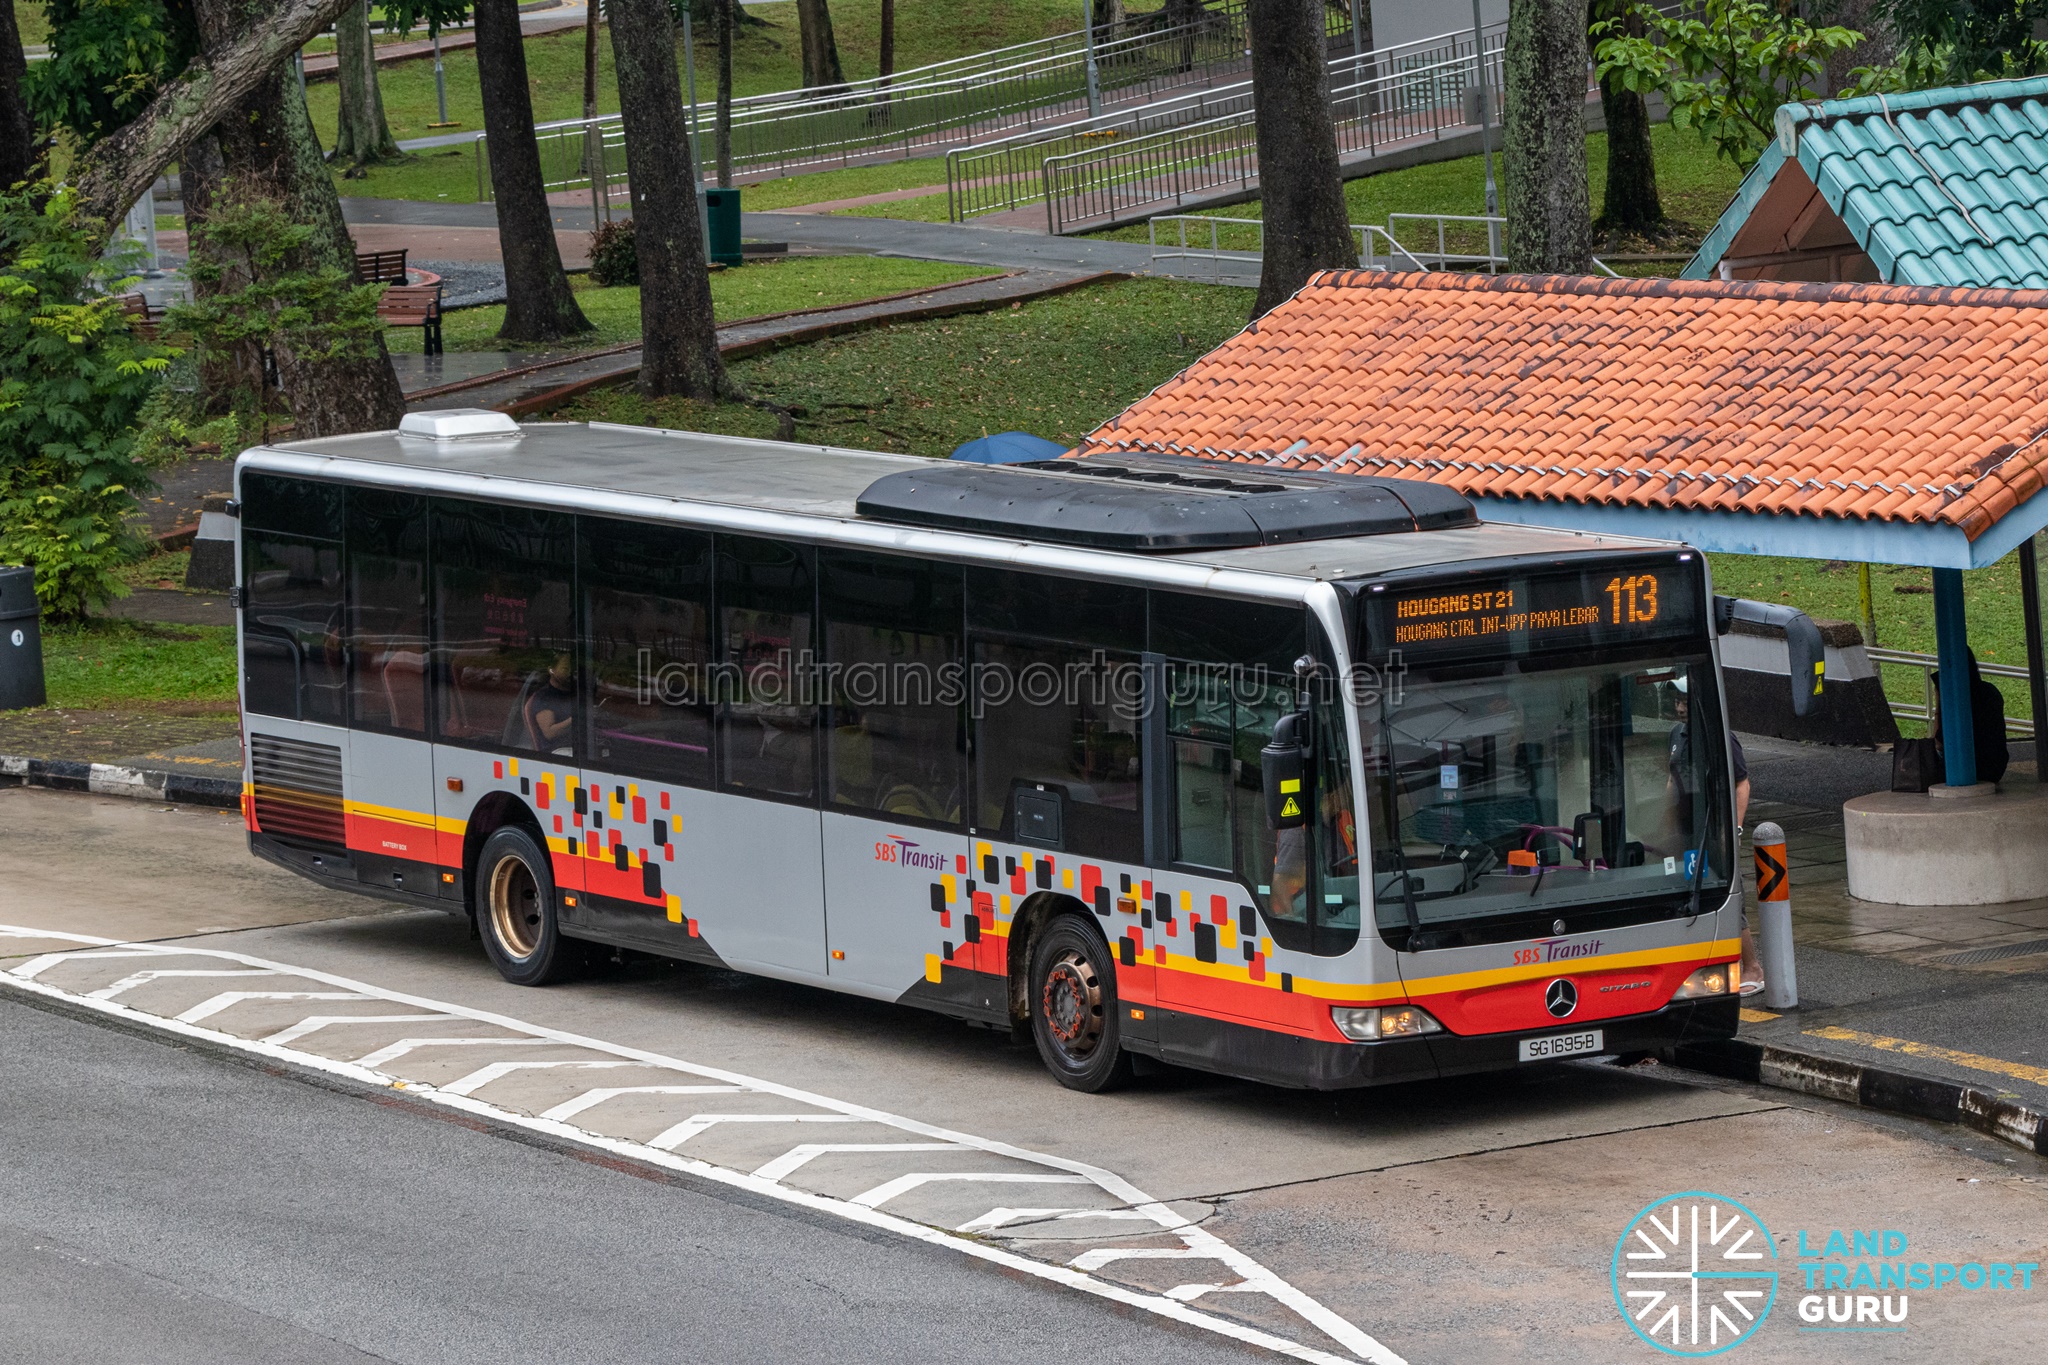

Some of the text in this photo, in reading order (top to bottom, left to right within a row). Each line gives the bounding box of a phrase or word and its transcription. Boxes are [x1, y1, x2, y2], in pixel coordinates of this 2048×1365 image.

[1397, 589, 1513, 618] HOUGANG ST 21
[1605, 574, 1658, 624] 113
[1396, 621, 1448, 643] HOUGANG
[1450, 618, 1478, 638] CTRL
[1529, 609, 1561, 629] PAYA
[1563, 605, 1599, 626] LEBAR
[875, 840, 949, 871] SBS Transit
[1513, 939, 1605, 966] SBS Transit
[1600, 980, 1652, 993] CITARO
[1529, 1033, 1595, 1057] SG1695B
